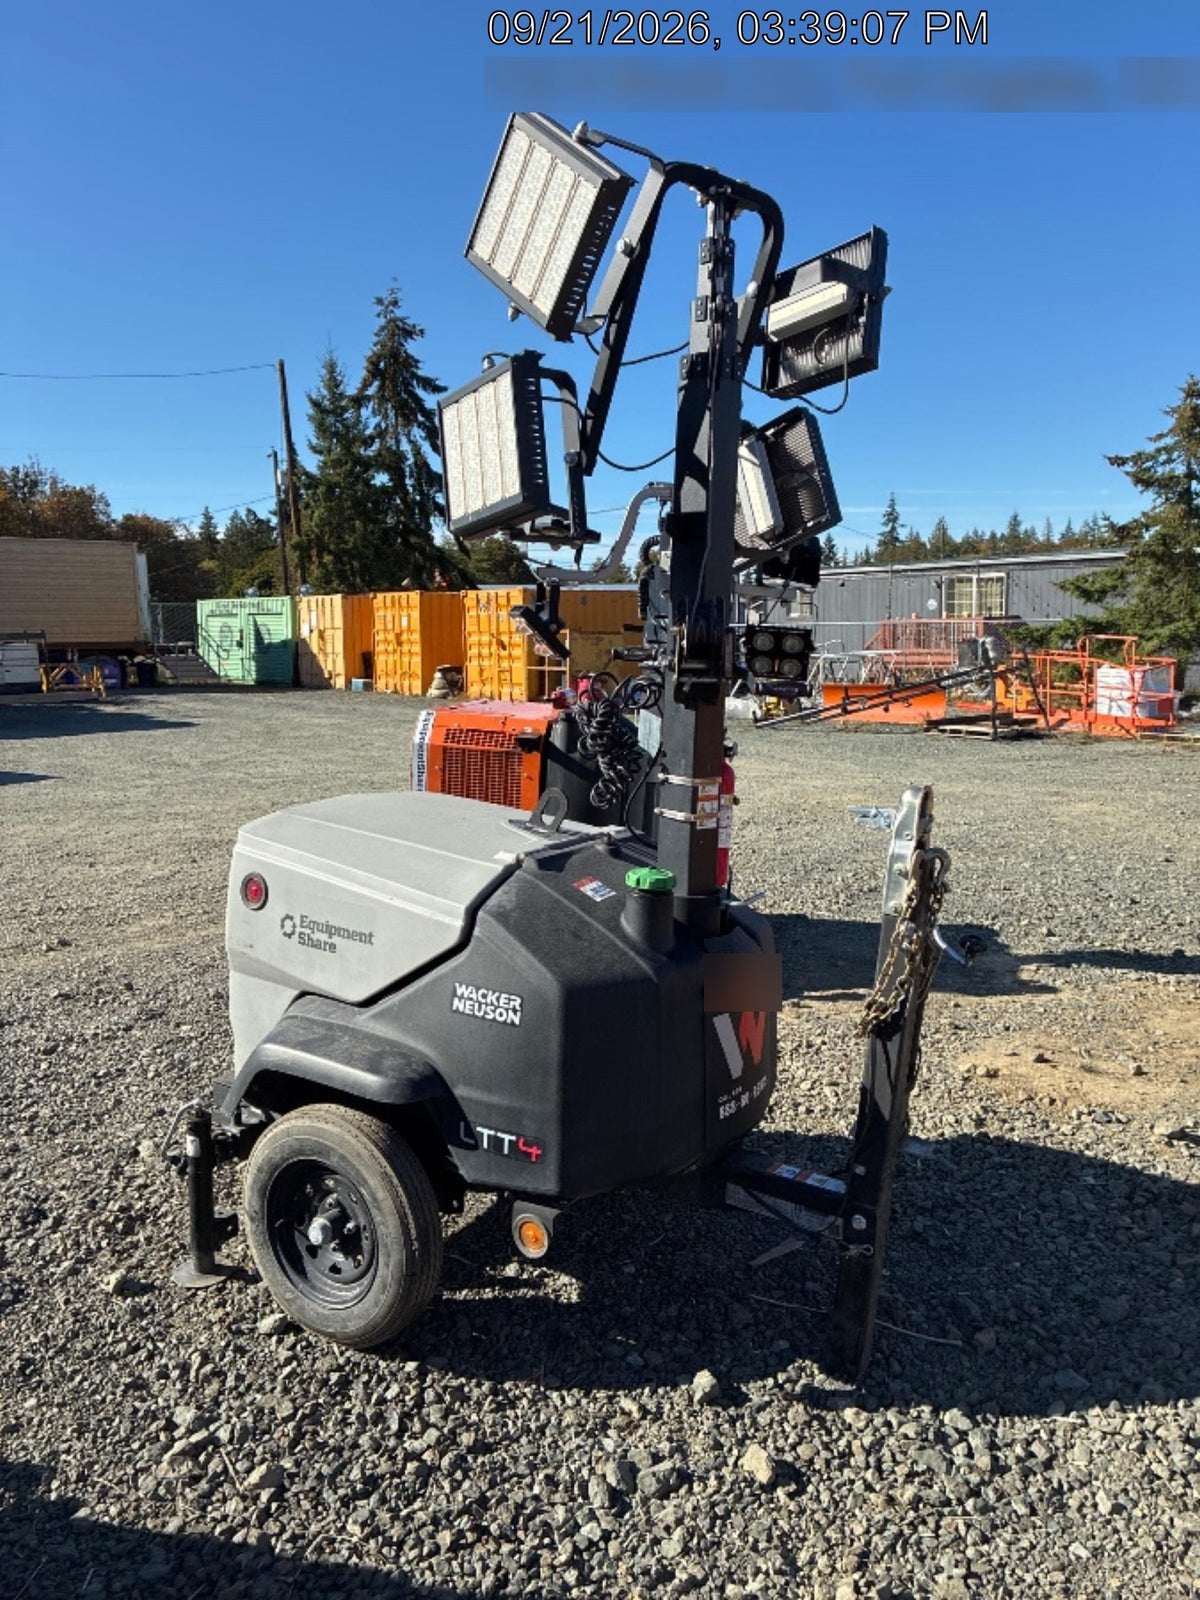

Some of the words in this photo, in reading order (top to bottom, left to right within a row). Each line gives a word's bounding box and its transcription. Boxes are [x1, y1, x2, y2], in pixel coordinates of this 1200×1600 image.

[297, 930, 337, 954] Share
[299, 913, 375, 947] Equipment
[452, 996, 521, 1026] NEUSON
[454, 981, 522, 1011] WACKER
